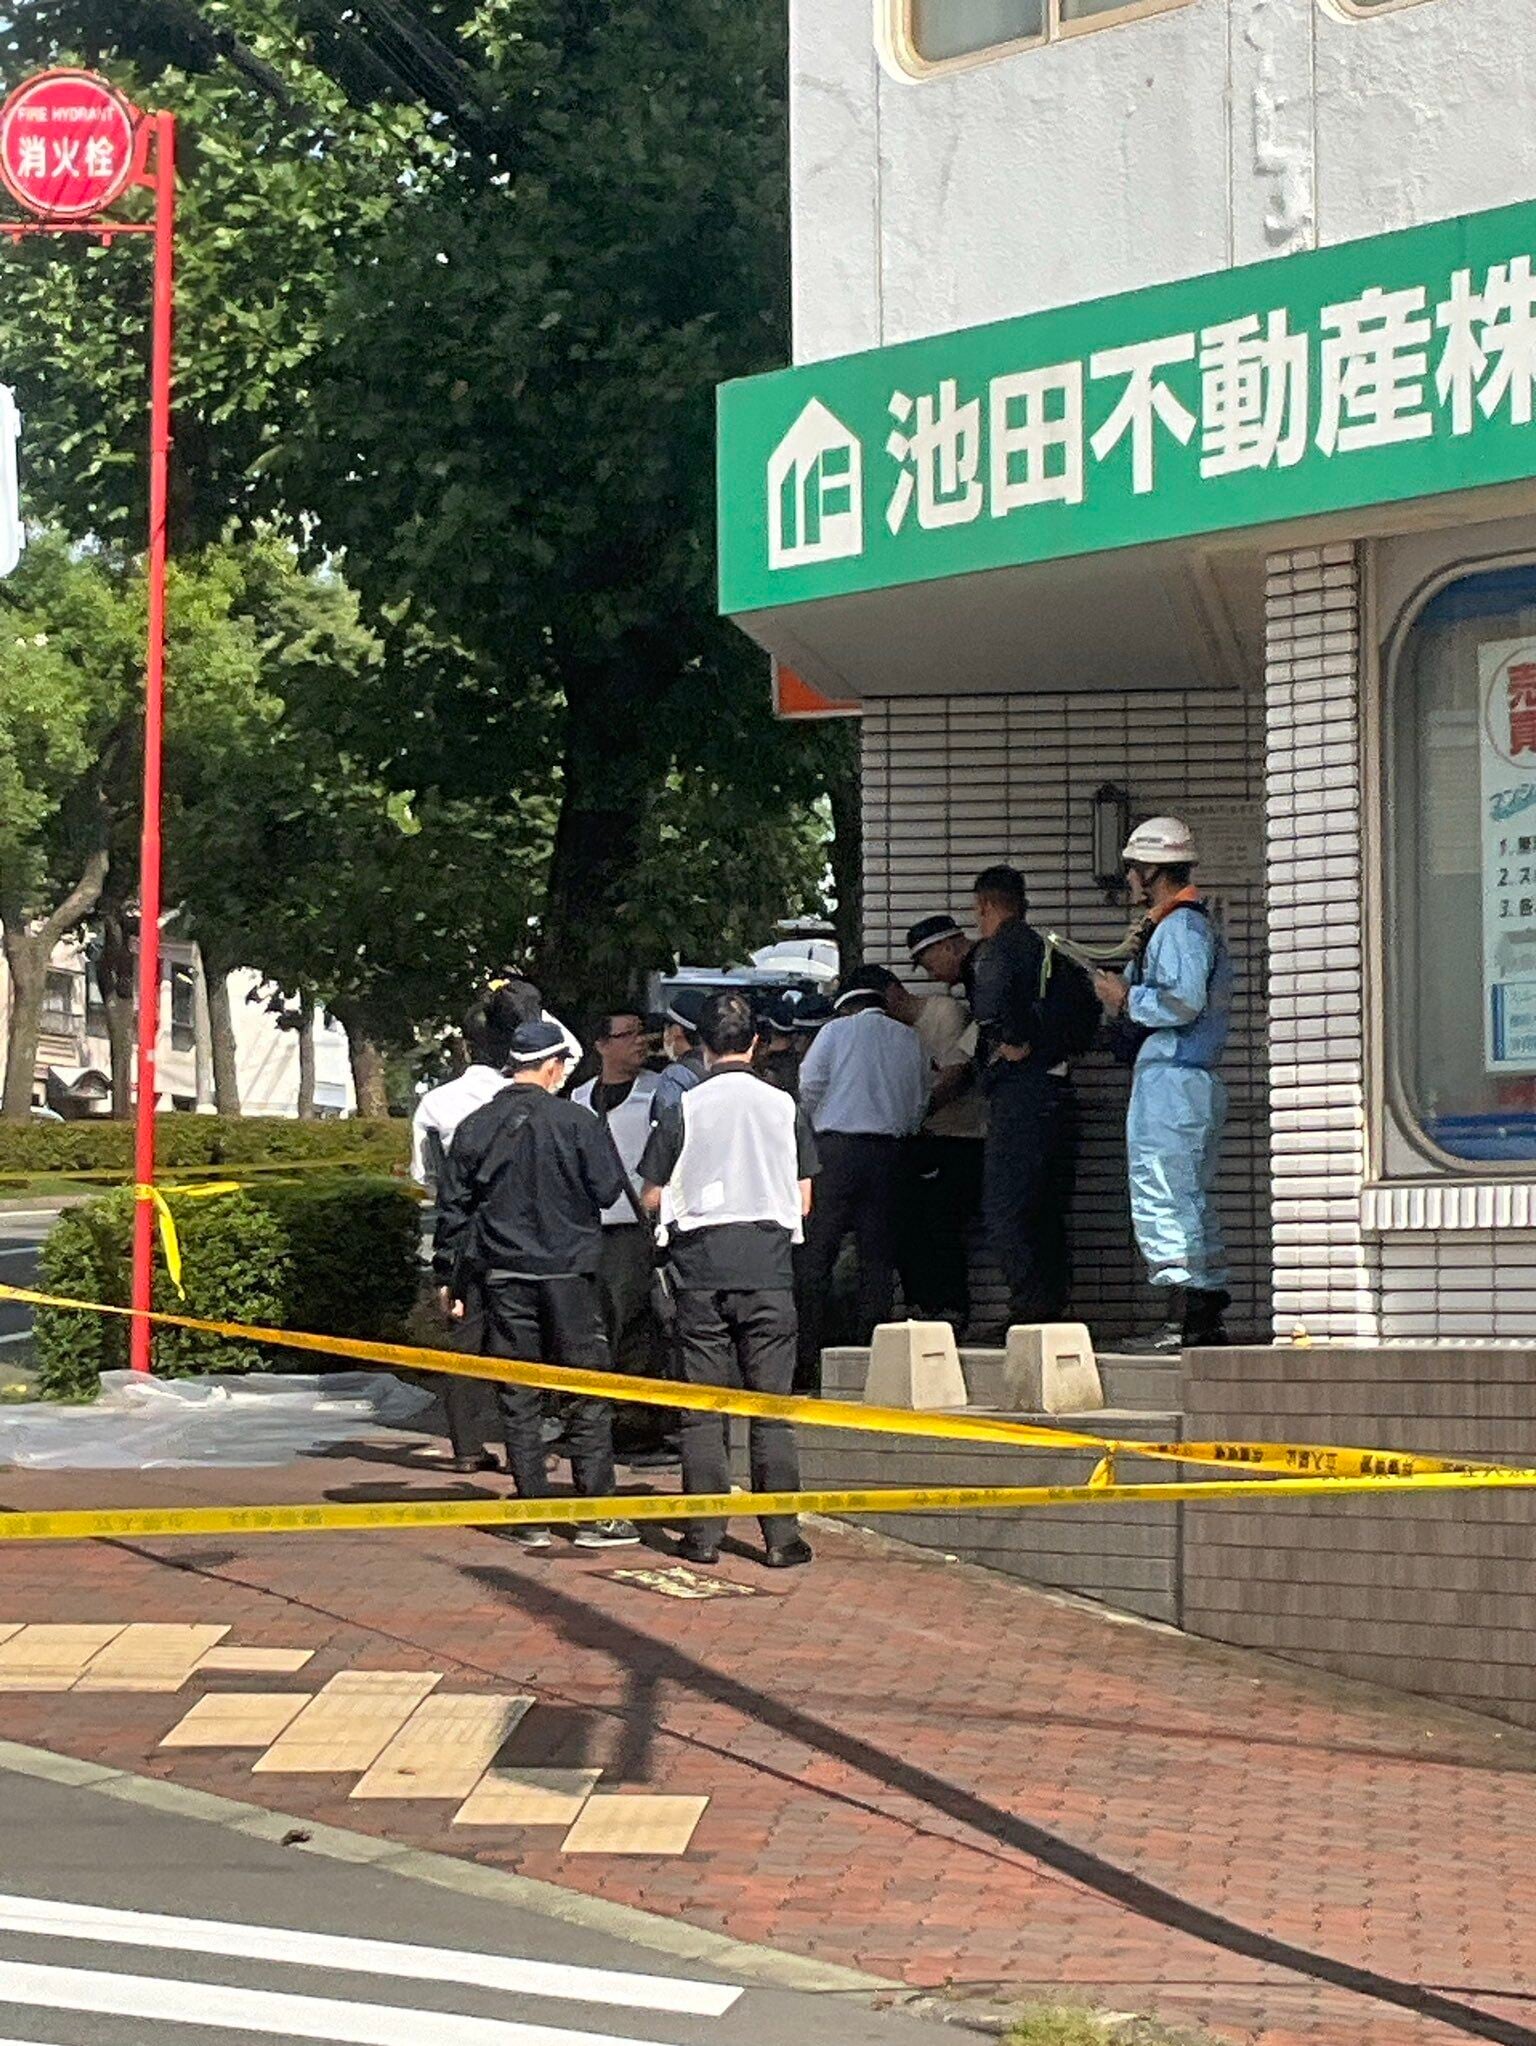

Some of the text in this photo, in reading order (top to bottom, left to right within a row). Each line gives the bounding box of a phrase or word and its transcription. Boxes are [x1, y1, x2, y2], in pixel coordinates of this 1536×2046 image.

[17, 105, 116, 122] FIRE HYDRANT
[17, 134, 116, 178] 消火栓
[884, 254, 1536, 536] 池田不動産株
